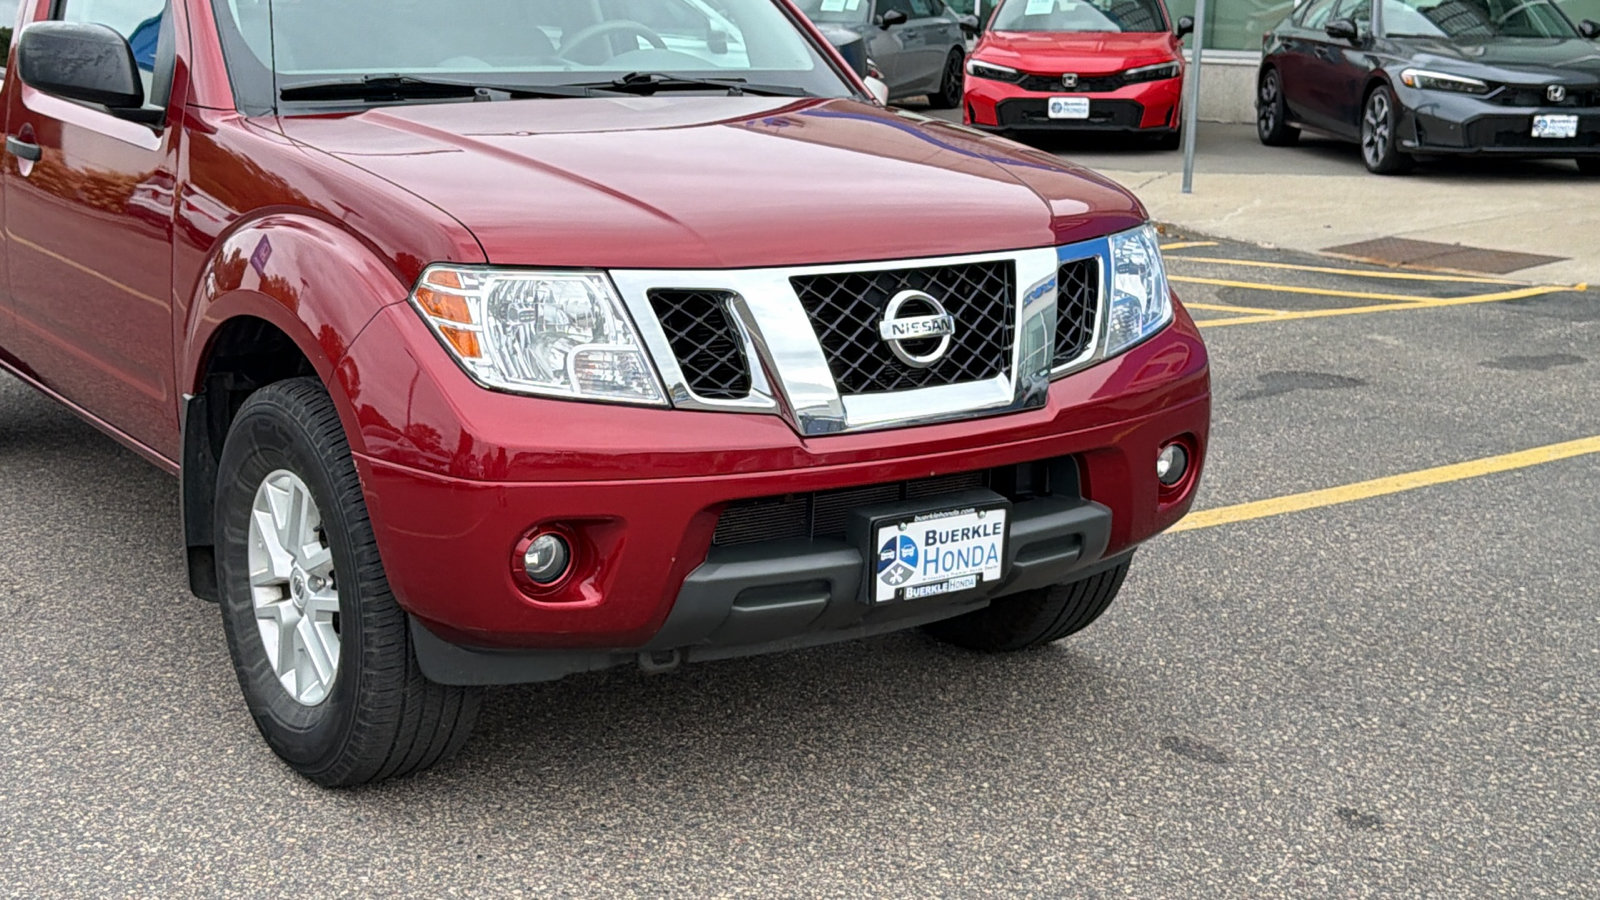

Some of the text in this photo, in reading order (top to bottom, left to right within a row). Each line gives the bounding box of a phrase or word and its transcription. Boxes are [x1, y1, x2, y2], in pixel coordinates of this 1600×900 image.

[892, 318, 951, 336] NISSAN
[924, 522, 1002, 547] BUERKLE
[923, 543, 999, 576] HONDA
[906, 578, 974, 598] BUERKLE HONDA
